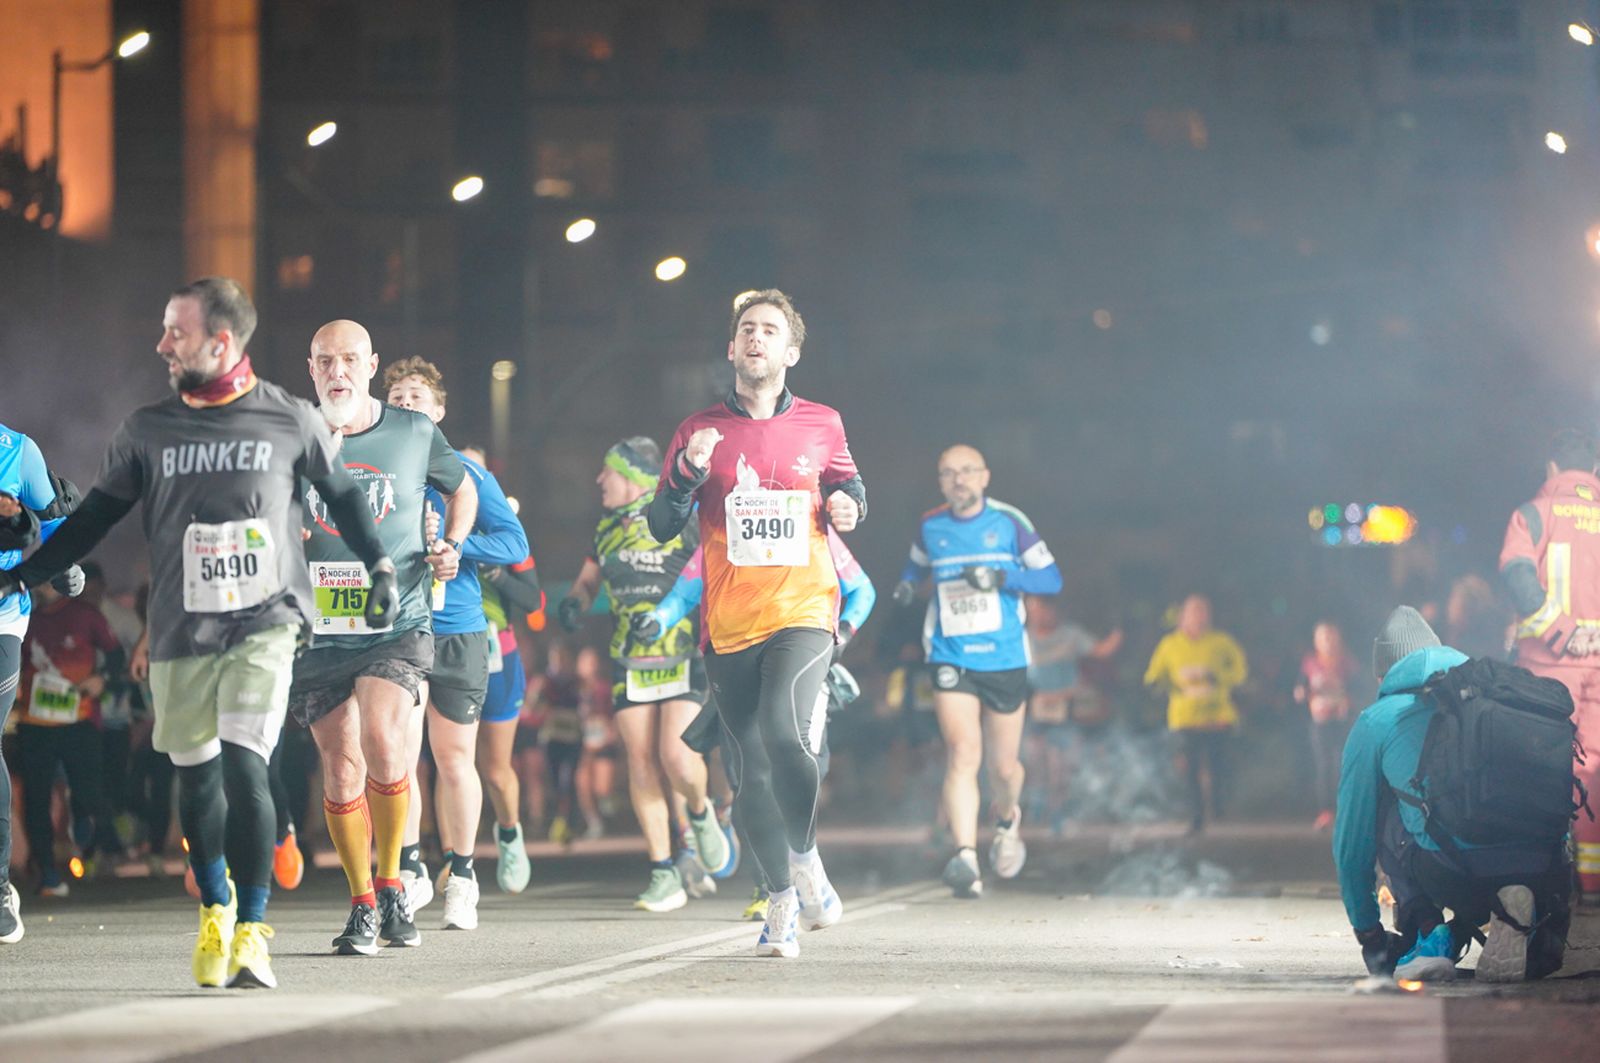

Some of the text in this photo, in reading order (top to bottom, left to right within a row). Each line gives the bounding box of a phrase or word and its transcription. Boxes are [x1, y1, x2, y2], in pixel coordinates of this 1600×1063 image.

[162, 440, 273, 479] BUNKER
[744, 499, 768, 507] NOCHE
[735, 508, 751, 517] SAN
[741, 517, 795, 540] 3490
[201, 552, 258, 582] 5490
[327, 570, 362, 578] NOCHE DE
[319, 578, 335, 587] SAN
